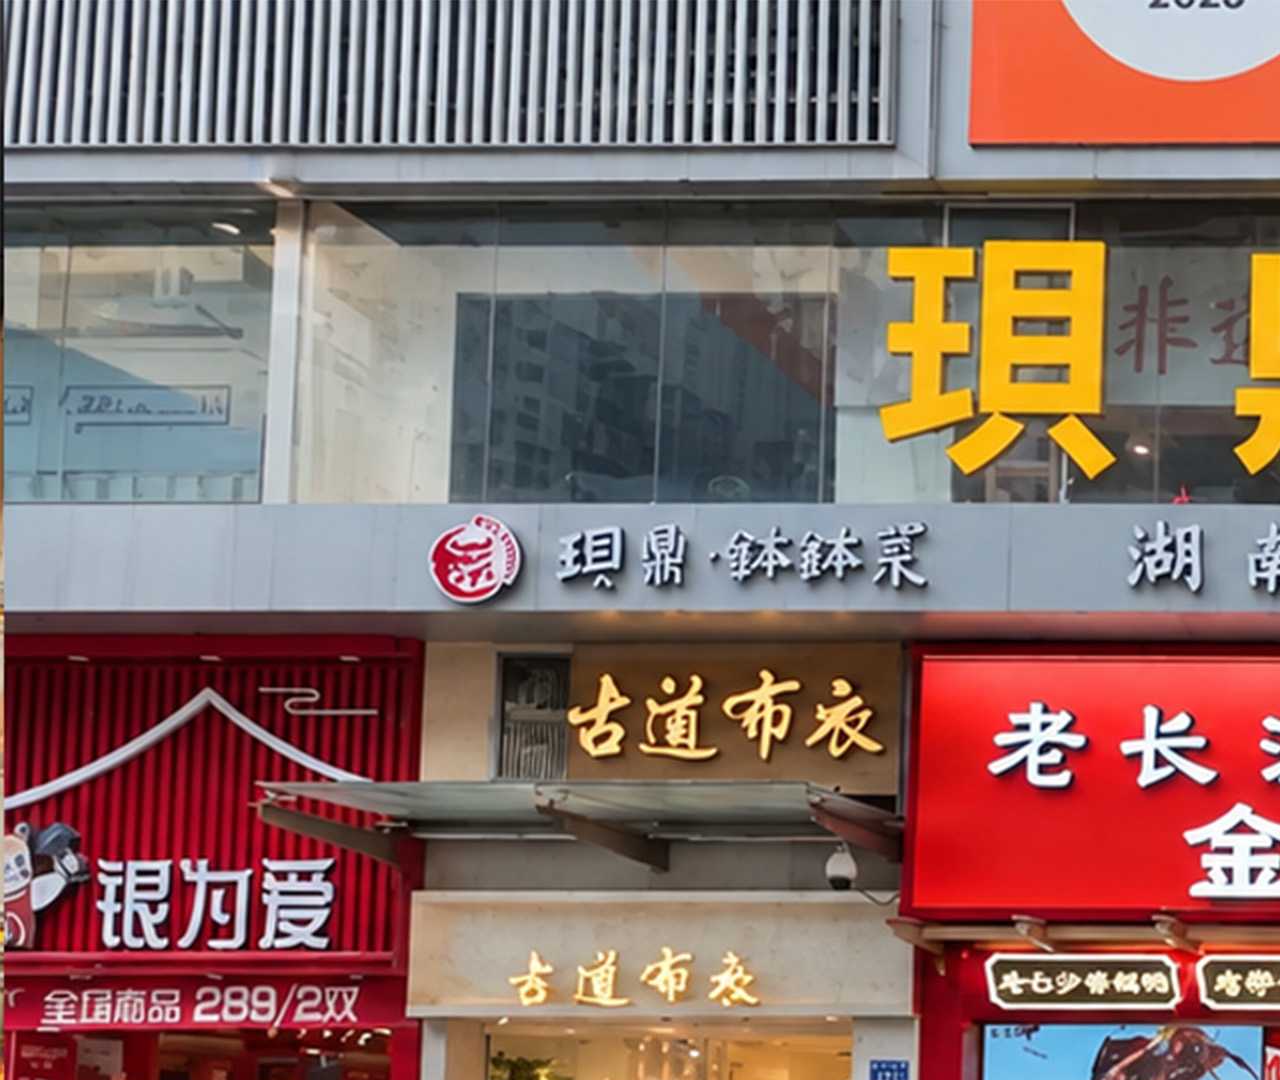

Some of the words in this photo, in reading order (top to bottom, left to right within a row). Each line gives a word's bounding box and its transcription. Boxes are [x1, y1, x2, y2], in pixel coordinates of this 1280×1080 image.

[567, 669, 884, 760] 古道布衣
[509, 947, 761, 1007] 古道布衣
